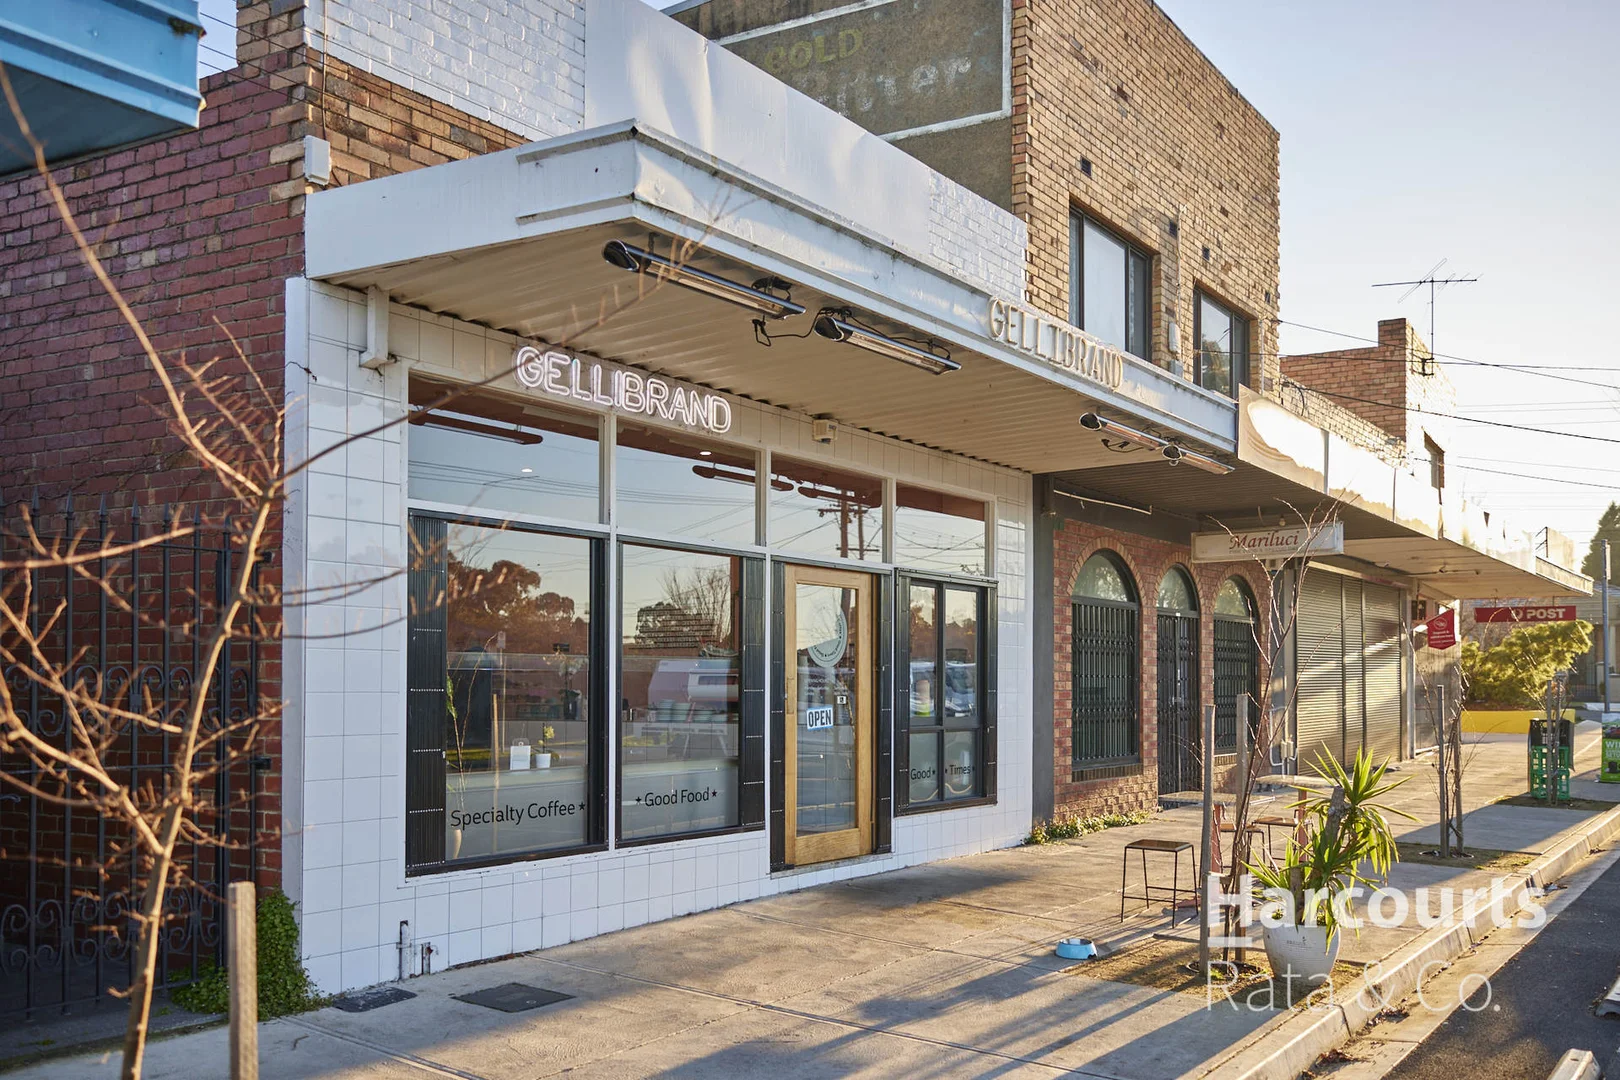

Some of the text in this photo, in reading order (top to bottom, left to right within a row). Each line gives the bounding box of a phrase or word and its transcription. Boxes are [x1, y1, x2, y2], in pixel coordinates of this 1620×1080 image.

[988, 296, 1123, 391] GELLIBRAND
[516, 346, 732, 433] GELLIBRAND
[1229, 531, 1300, 549] Mariluci
[1526, 608, 1566, 619] POST
[808, 710, 831, 727] OPEN
[910, 767, 931, 780] Good
[949, 764, 971, 775] Times
[644, 787, 710, 807] Good Food
[450, 802, 576, 831] Specialty Coffee
